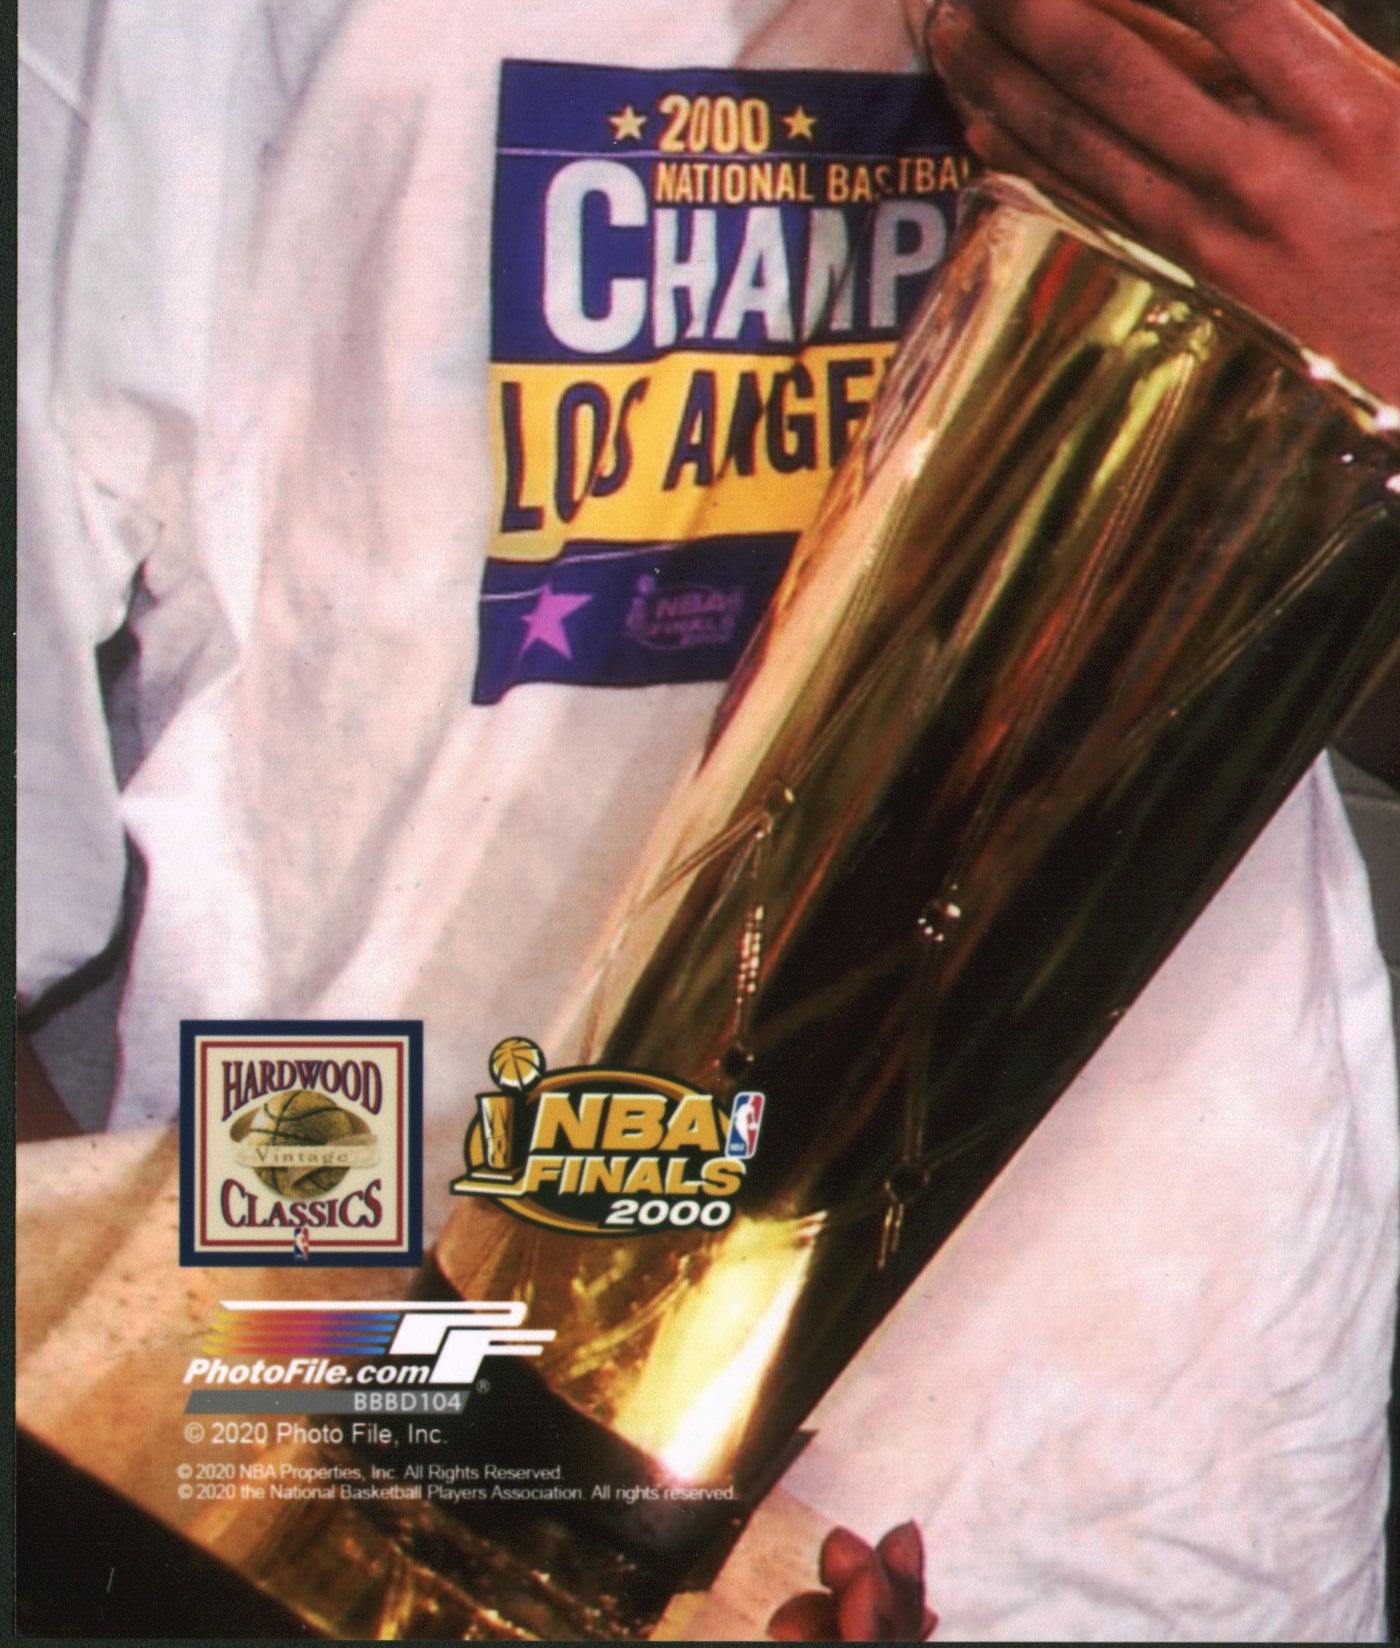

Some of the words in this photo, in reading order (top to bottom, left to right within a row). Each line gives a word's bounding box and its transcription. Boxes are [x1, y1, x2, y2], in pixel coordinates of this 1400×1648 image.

[657, 94, 771, 154] 2000
[654, 160, 816, 203] NATIONAL
[500, 376, 652, 533] LOS
[661, 356, 890, 492] ANGE
